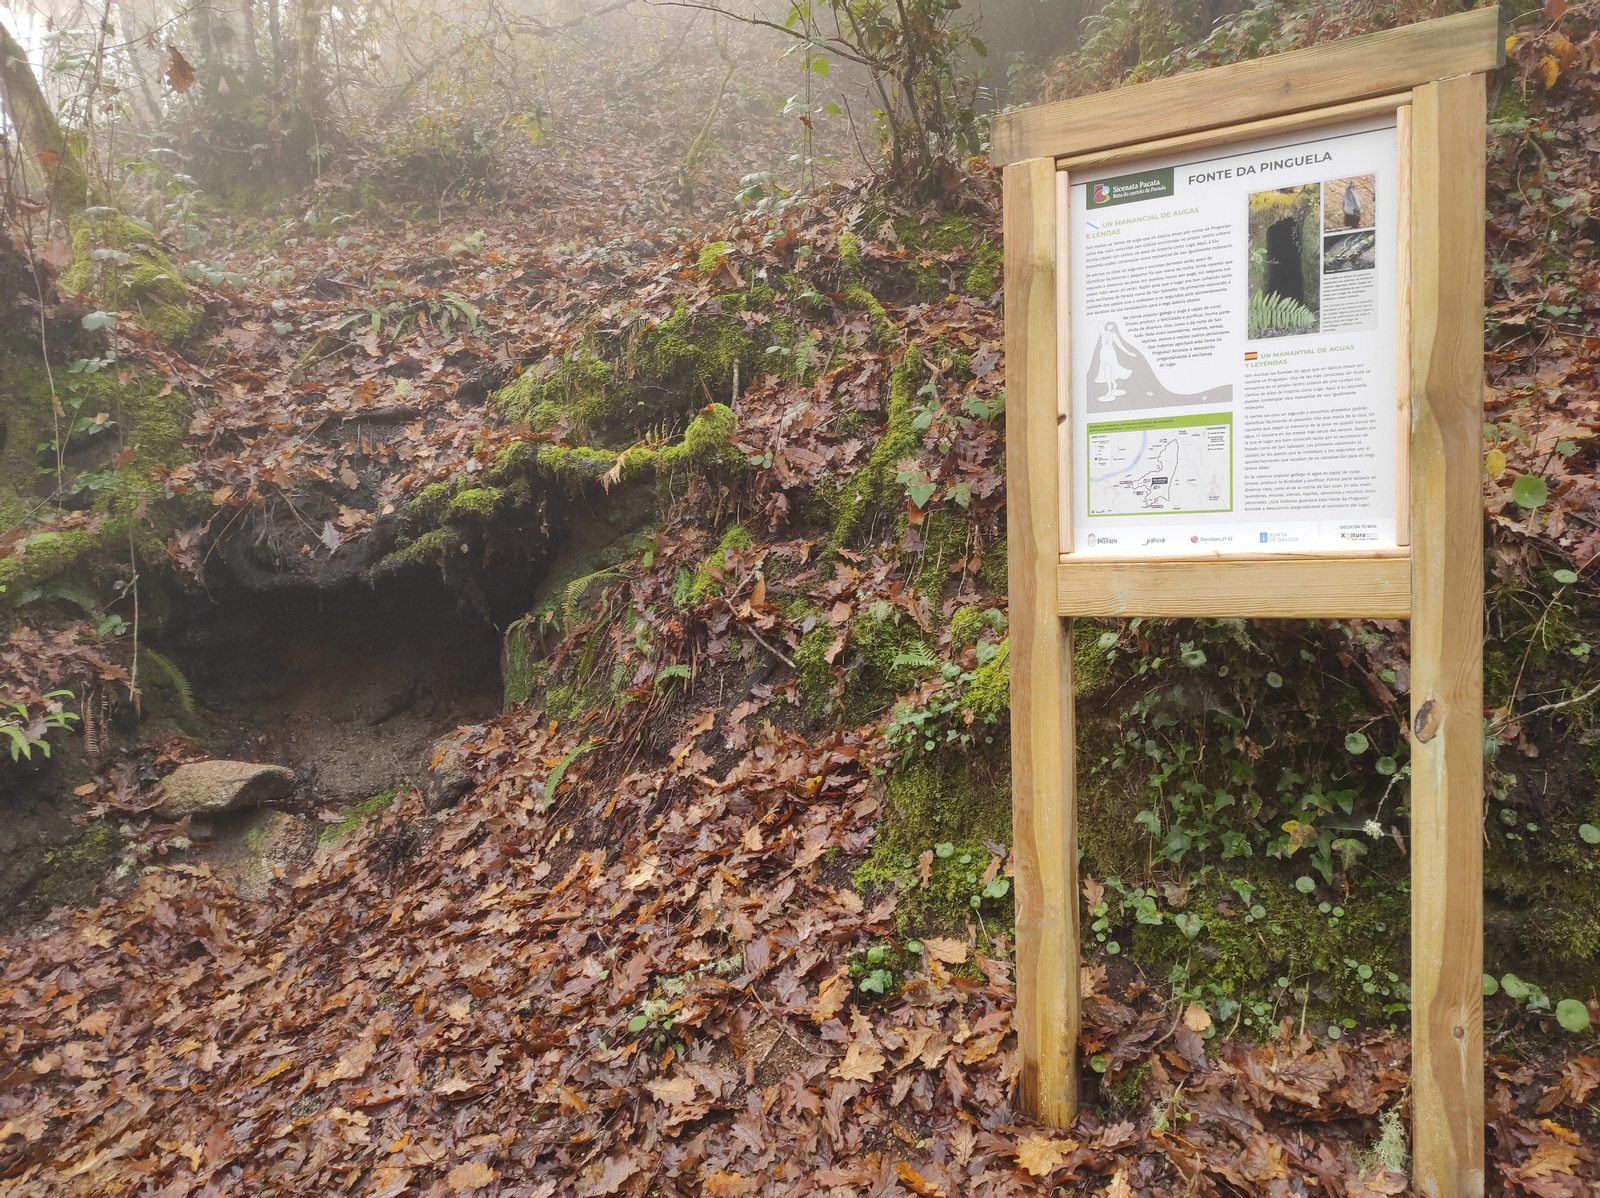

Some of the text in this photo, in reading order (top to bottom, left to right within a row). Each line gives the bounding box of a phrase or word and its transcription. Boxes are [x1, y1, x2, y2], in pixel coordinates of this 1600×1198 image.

[1188, 151, 1332, 185] FONTE DA PINGUELA
[1113, 180, 1160, 192] Sicenata Pacata
[1114, 214, 1159, 226] MANANCIAL
[1173, 207, 1200, 217] AUGAS
[1092, 229, 1121, 238] LENDAS
[1272, 349, 1315, 358] MANANTIAL
[1250, 359, 1288, 368] LEYENDAS
[1141, 537, 1165, 546] galicia
